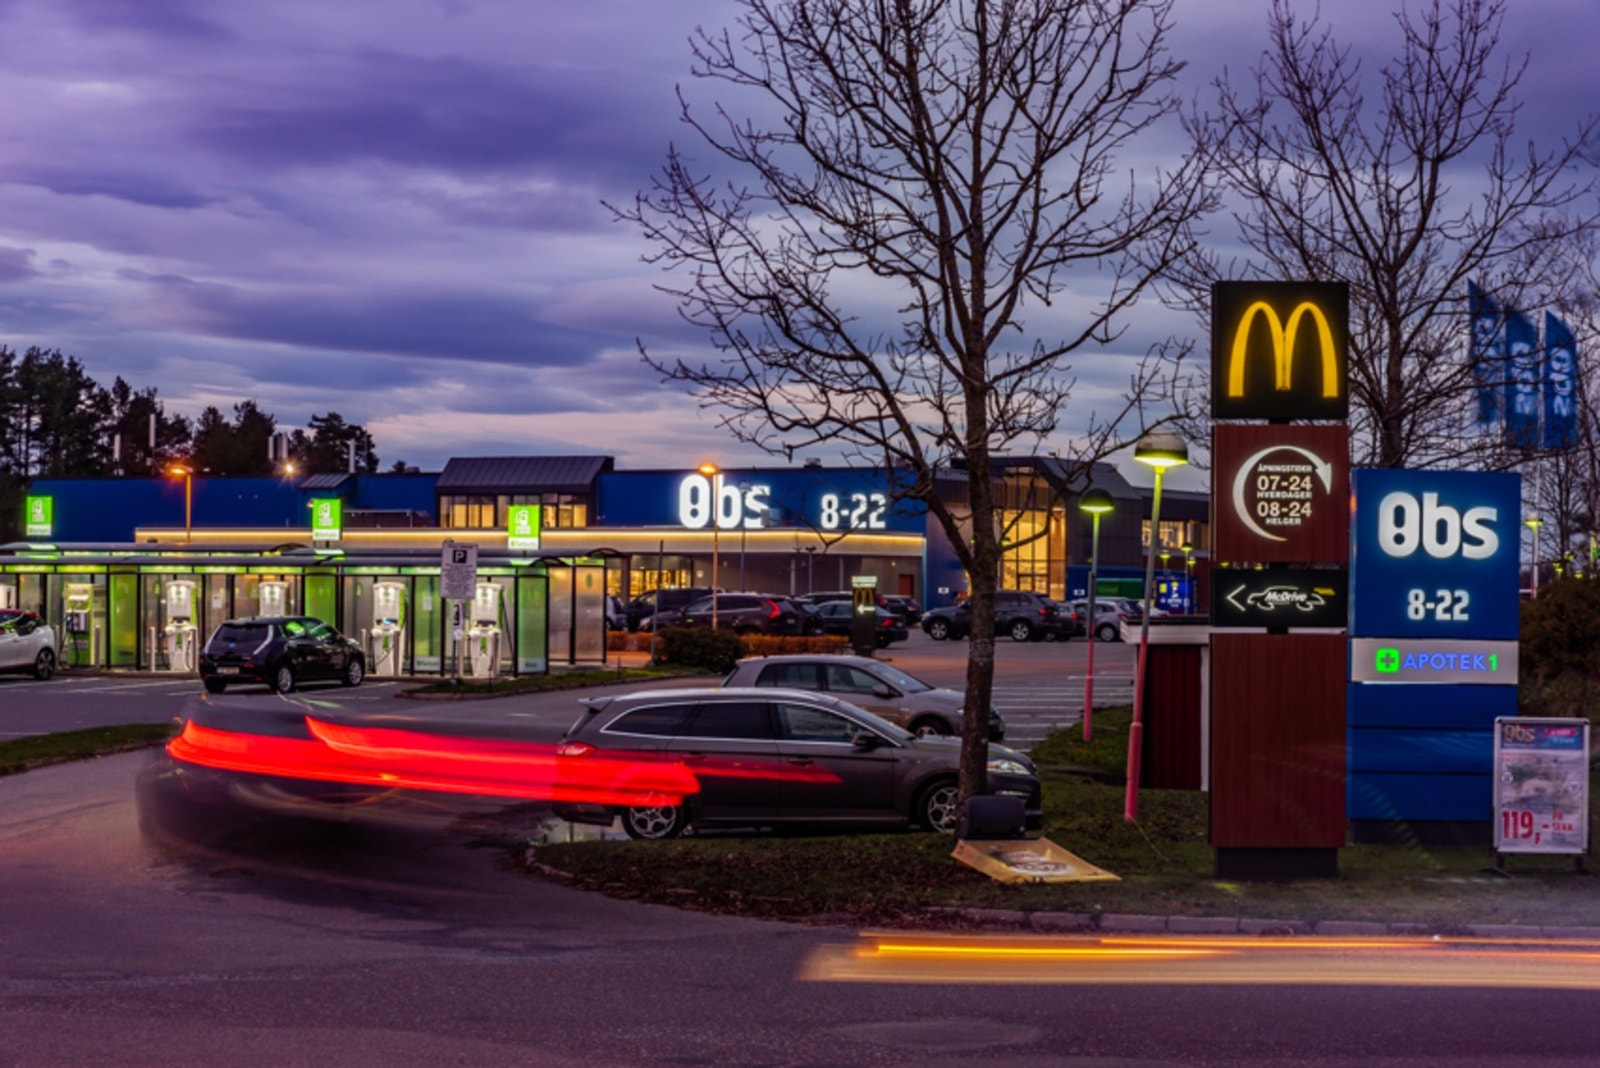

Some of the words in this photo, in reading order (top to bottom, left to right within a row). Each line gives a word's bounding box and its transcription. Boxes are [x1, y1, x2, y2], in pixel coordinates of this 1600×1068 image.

[1257, 475, 1312, 491] 07-24
[678, 474, 770, 529] Obs
[1257, 491, 1312, 499] HVERDAGER
[820, 493, 887, 530] 8-22
[1257, 501, 1312, 517] 08-24
[1265, 517, 1302, 526] HELGER
[1378, 491, 1499, 559] Obs
[1264, 591, 1308, 602] McDrive
[1407, 588, 1469, 621] 8-22
[1403, 652, 1487, 671] APOTEK
[1504, 725, 1536, 743] Obs
